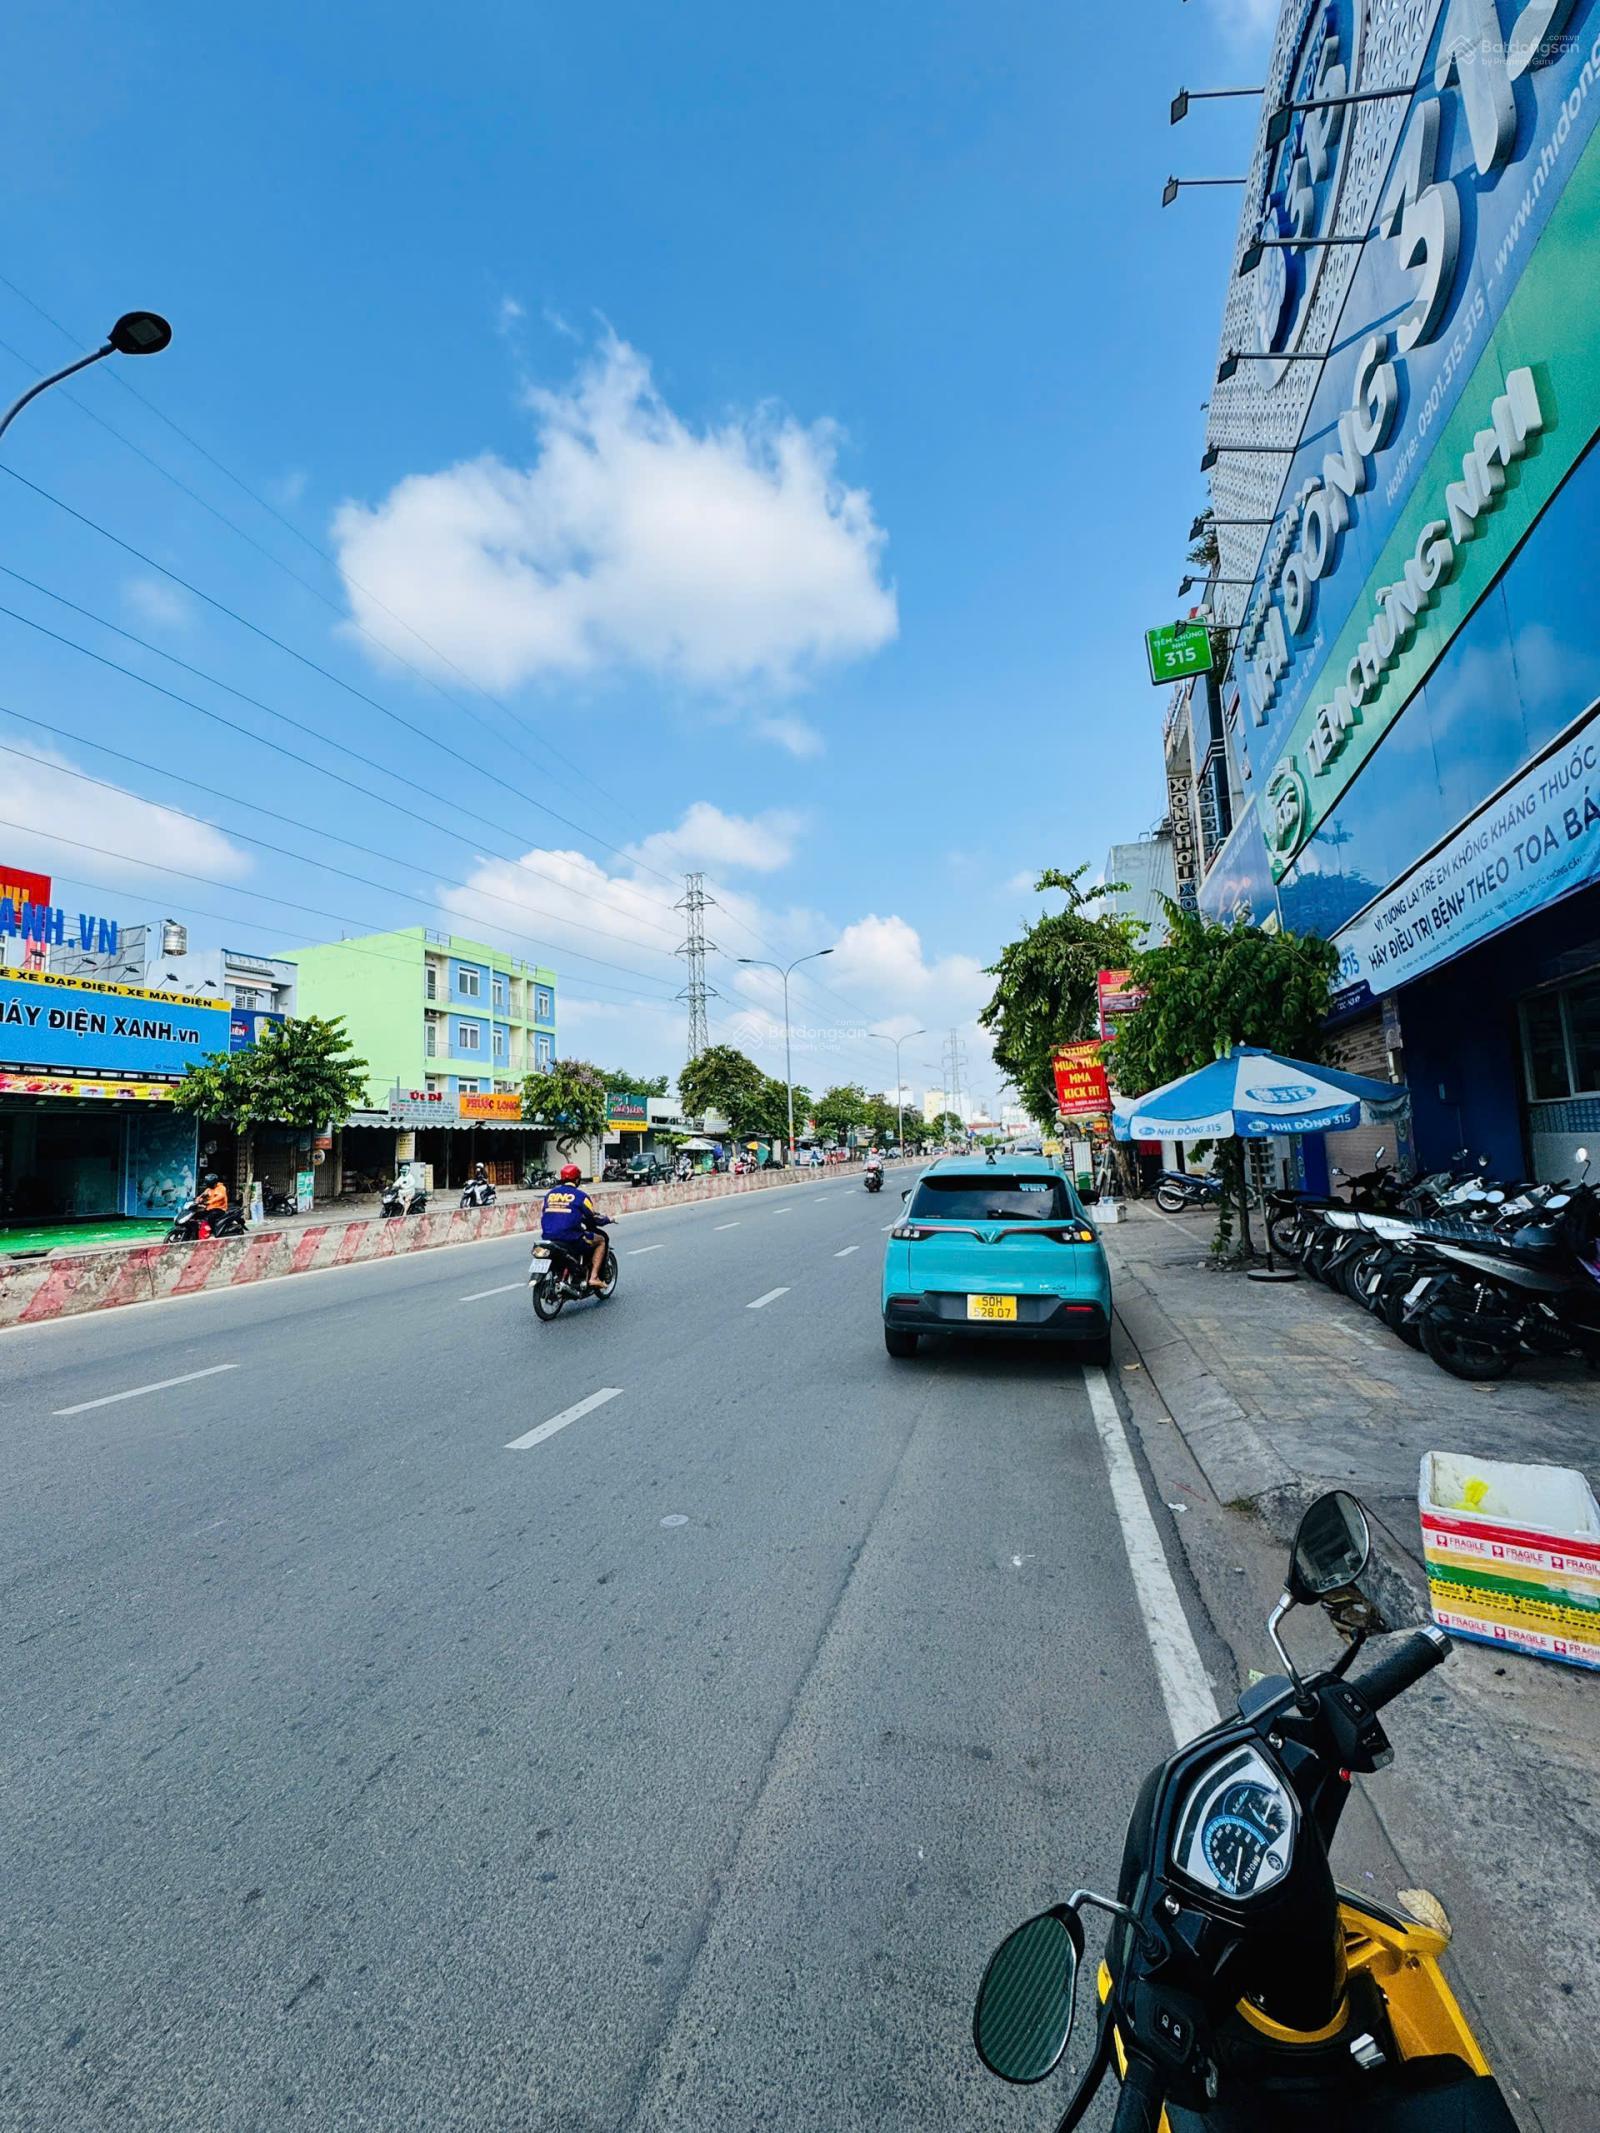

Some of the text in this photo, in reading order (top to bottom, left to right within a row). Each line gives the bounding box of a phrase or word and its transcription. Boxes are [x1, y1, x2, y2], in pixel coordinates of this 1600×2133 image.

[1385, 437, 1420, 506] Hotline:
[1246, 605, 1289, 728] NHI
[1282, 334, 1398, 636] ĐỒNG
[1305, 366, 1543, 777] TIÊM CHỦNG NHI
[1164, 647, 1197, 667] 315
[1171, 641, 1187, 650] NHI
[1374, 913, 1384, 933] VÌ
[1406, 888, 1420, 910] LAI
[1436, 864, 1451, 886] EM
[1451, 831, 1490, 877] KHÔNG
[1490, 793, 1537, 845] KHÁNG
[1538, 744, 1598, 806] THUỐC
[1368, 944, 1388, 972] HÃY
[1387, 926, 1414, 960] ĐIỀU
[1412, 913, 1436, 941] TRỊ
[1431, 887, 1467, 931] BỆNH
[1466, 855, 1510, 905] THEO
[1513, 823, 1560, 872] TOA
[16, 970, 40, 983] XE
[44, 975, 77, 989] ĐẠP
[127, 988, 145, 997] XE
[0, 998, 42, 1026] ÁY
[49, 1007, 106, 1039] ĐIỆN
[113, 1017, 200, 1044] XANH.vn
[1054, 1060, 1078, 1072] MUAY
[1069, 1072, 1092, 1084] MMA
[1063, 1086, 1087, 1100] KICK
[1157, 1127, 1175, 1136] NHI
[1177, 1125, 1205, 1136] ĐỒNG
[1205, 1123, 1222, 1133] 315
[1271, 1121, 1292, 1132] NHI
[1294, 1117, 1332, 1131] ĐỒNG
[1332, 1113, 1351, 1126] 315
[982, 1296, 1003, 1307] 50H
[1449, 1538, 1485, 1551] FRAGILE
[1506, 1547, 1545, 1562] FRAGILE
[1451, 1615, 1488, 1632] FRAGILE
[1508, 1629, 1547, 1646] FRAGILE
